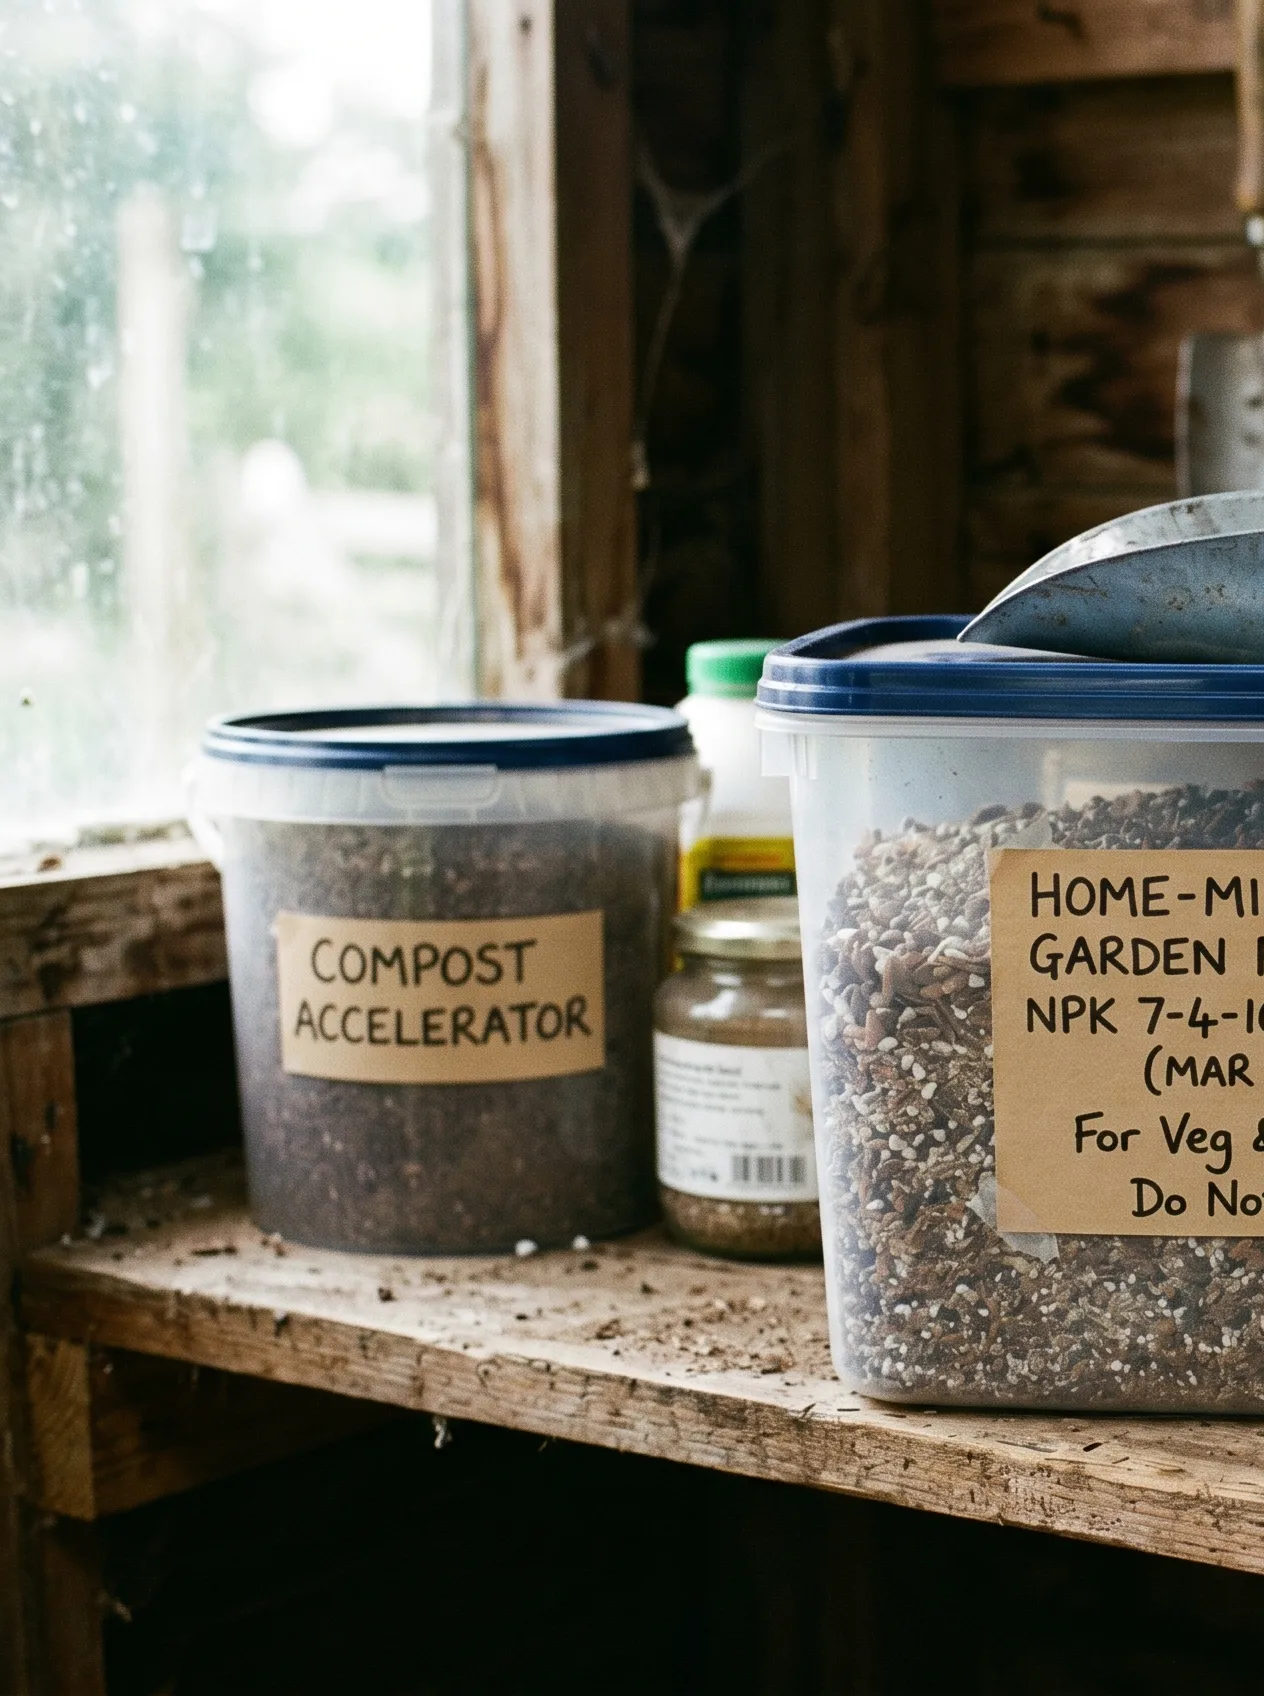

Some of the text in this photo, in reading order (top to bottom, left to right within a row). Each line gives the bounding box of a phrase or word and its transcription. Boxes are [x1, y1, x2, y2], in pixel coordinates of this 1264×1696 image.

[311, 937, 538, 988] COMPOST
[1029, 932, 1226, 981] GARDEN
[294, 995, 593, 1048] ACCELERATOR
[1026, 994, 1118, 1035] NPK
[1143, 1044, 1255, 1097] (MAR
[1074, 1110, 1142, 1154] For
[1158, 1111, 1233, 1175] Veg
[1129, 1177, 1188, 1218] Do
